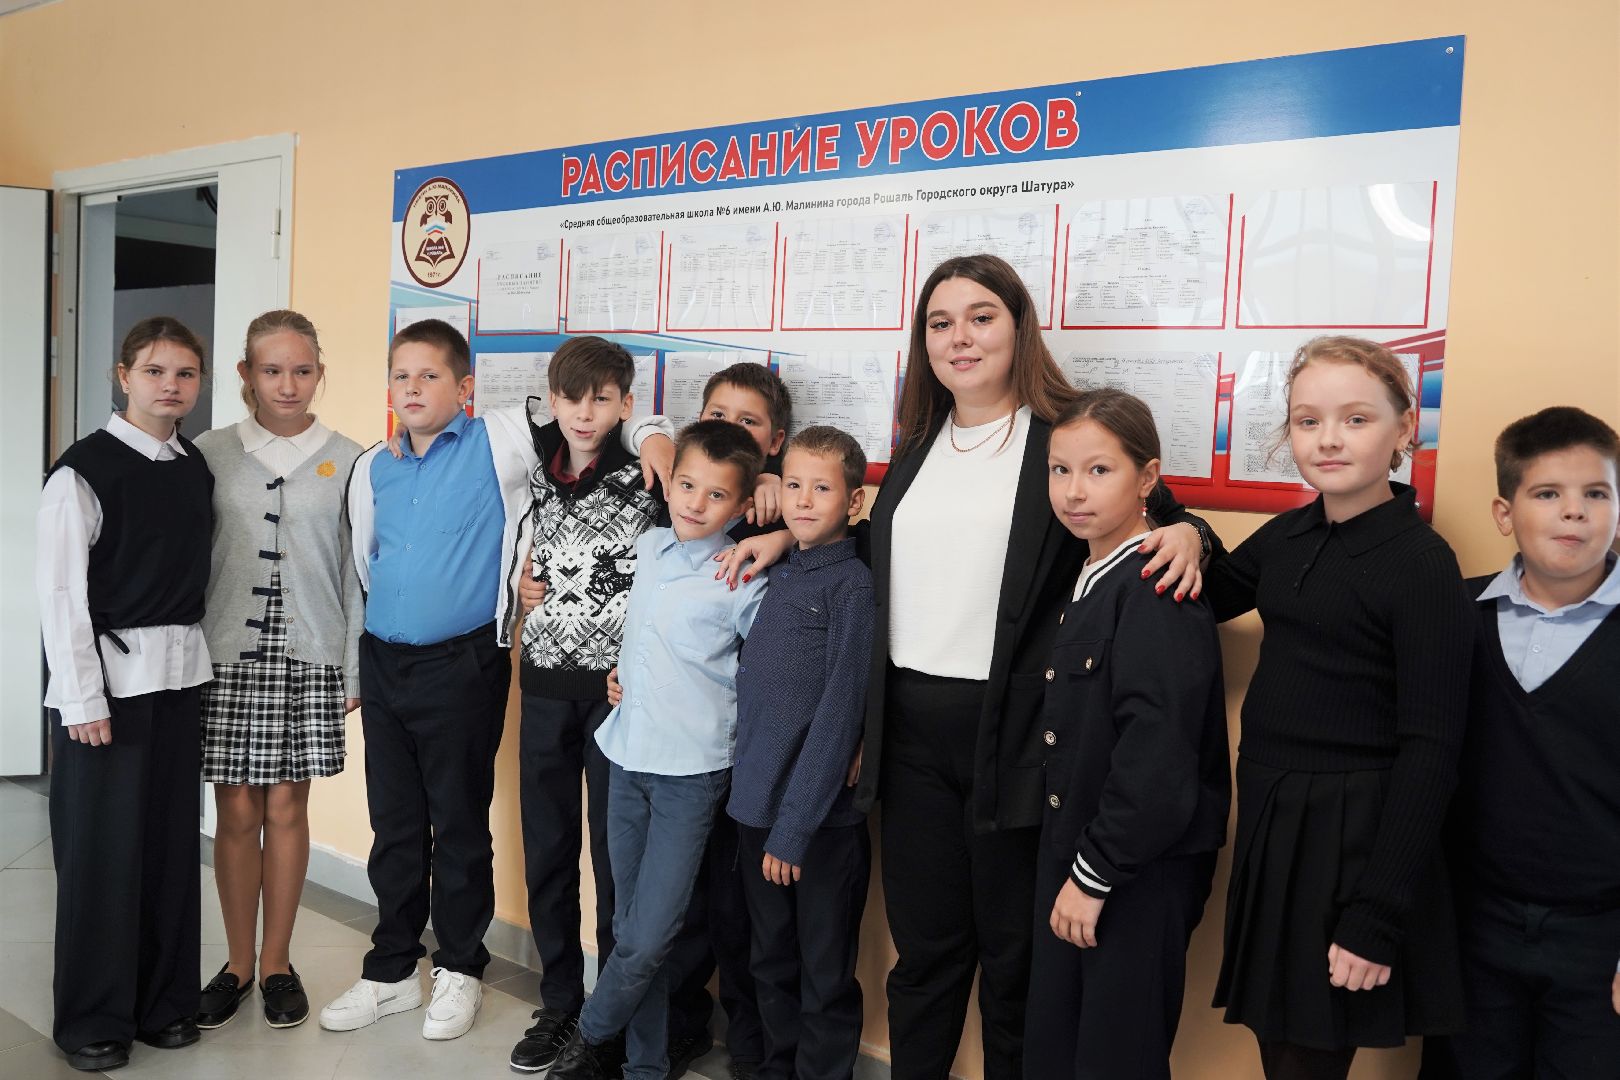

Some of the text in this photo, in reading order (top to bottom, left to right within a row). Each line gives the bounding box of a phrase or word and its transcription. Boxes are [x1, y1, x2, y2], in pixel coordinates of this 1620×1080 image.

[561, 97, 1080, 197] РАСПИСАНИЕ УРОКОВ
[560, 180, 1075, 230] «Средняя общеобразовательная школа №6 имени А.Ю. Малинина города Рошаль Городского округа Шатура»
